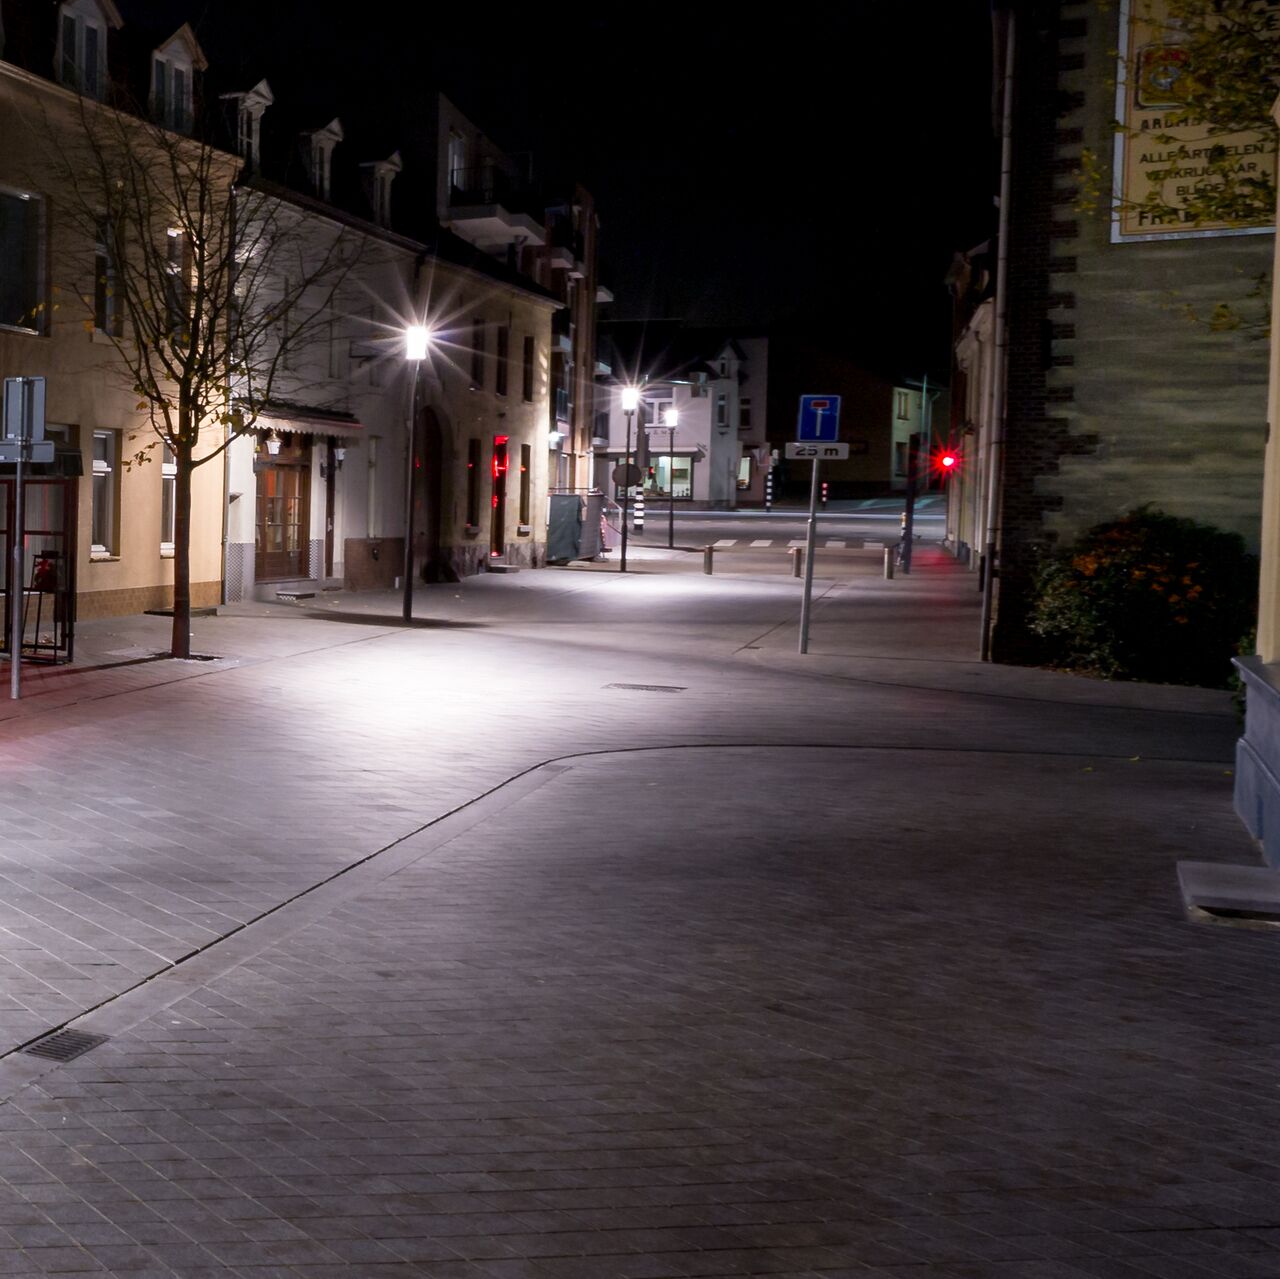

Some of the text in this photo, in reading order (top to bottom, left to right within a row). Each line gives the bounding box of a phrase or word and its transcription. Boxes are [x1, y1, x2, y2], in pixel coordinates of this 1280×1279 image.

[1183, 143, 1265, 159] ARTELEN
[795, 445, 839, 456] 25 m
